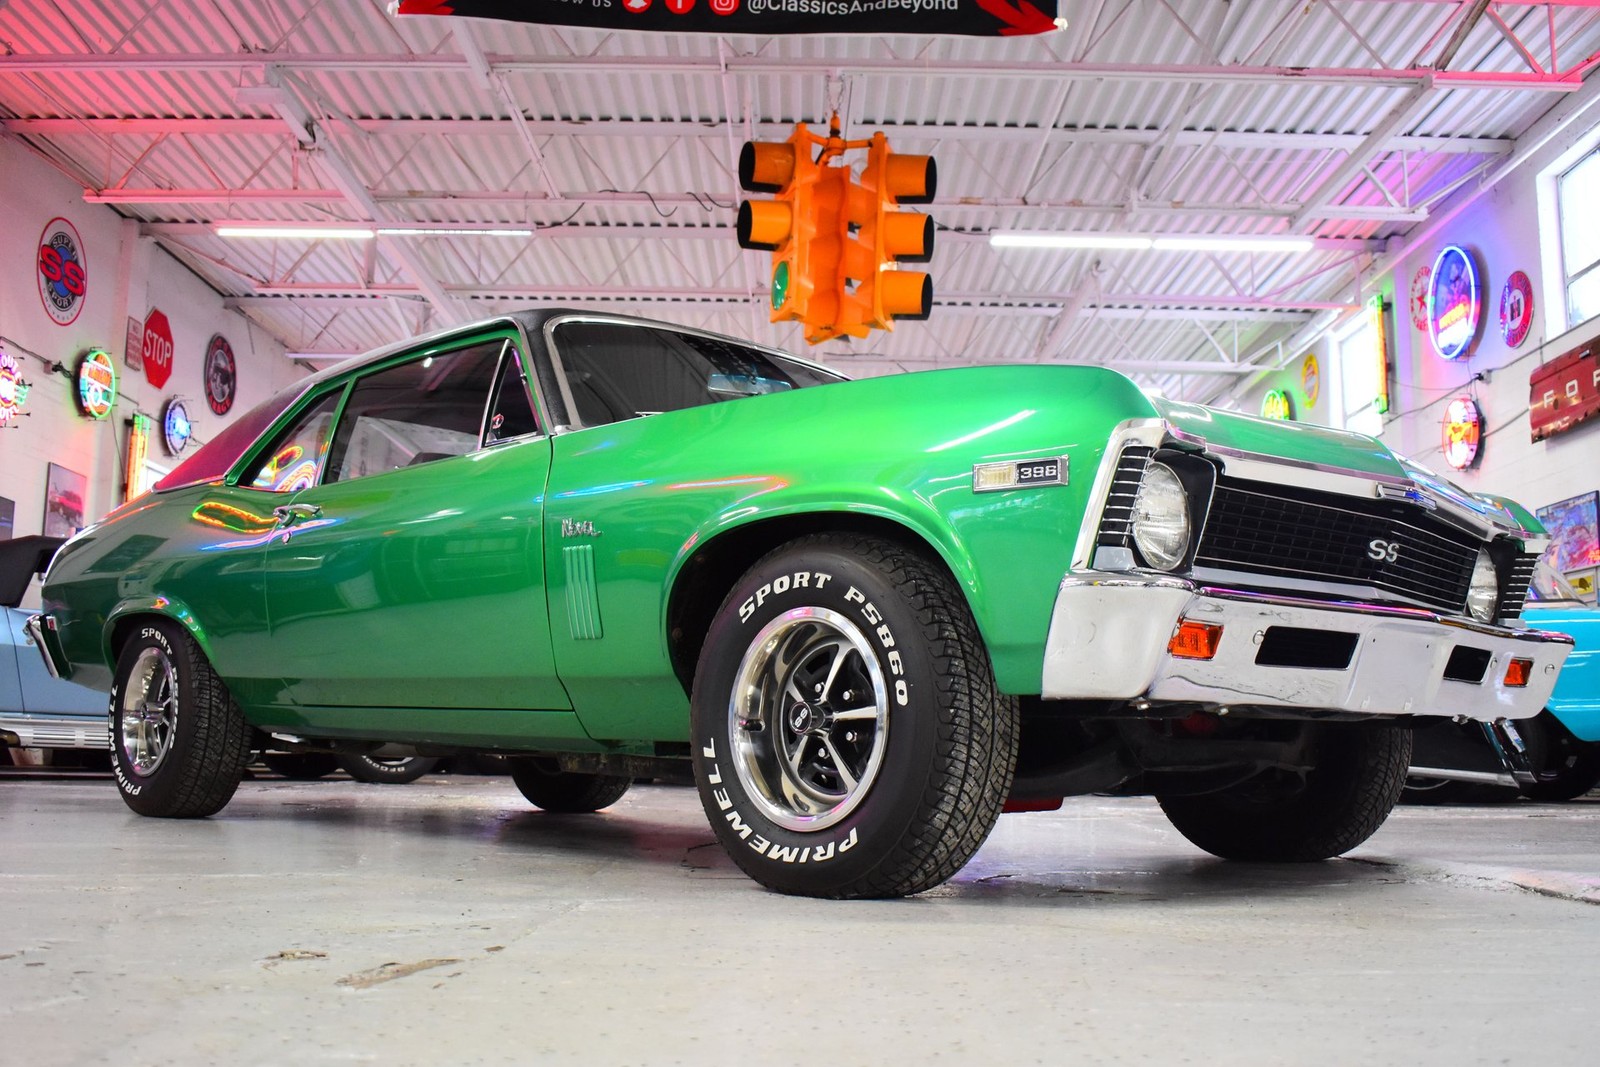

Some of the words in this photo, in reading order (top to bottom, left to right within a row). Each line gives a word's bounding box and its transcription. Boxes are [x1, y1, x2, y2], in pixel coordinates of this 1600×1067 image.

[144, 328, 172, 369] STOP
[1020, 465, 1057, 479] 396
[1367, 539, 1400, 562] SS
[141, 627, 173, 656] SPORT
[738, 571, 832, 624] SPORT
[843, 586, 909, 706] PS860
[108, 684, 142, 796] PRIMEWELL
[702, 737, 859, 864] PRIMEWELL
